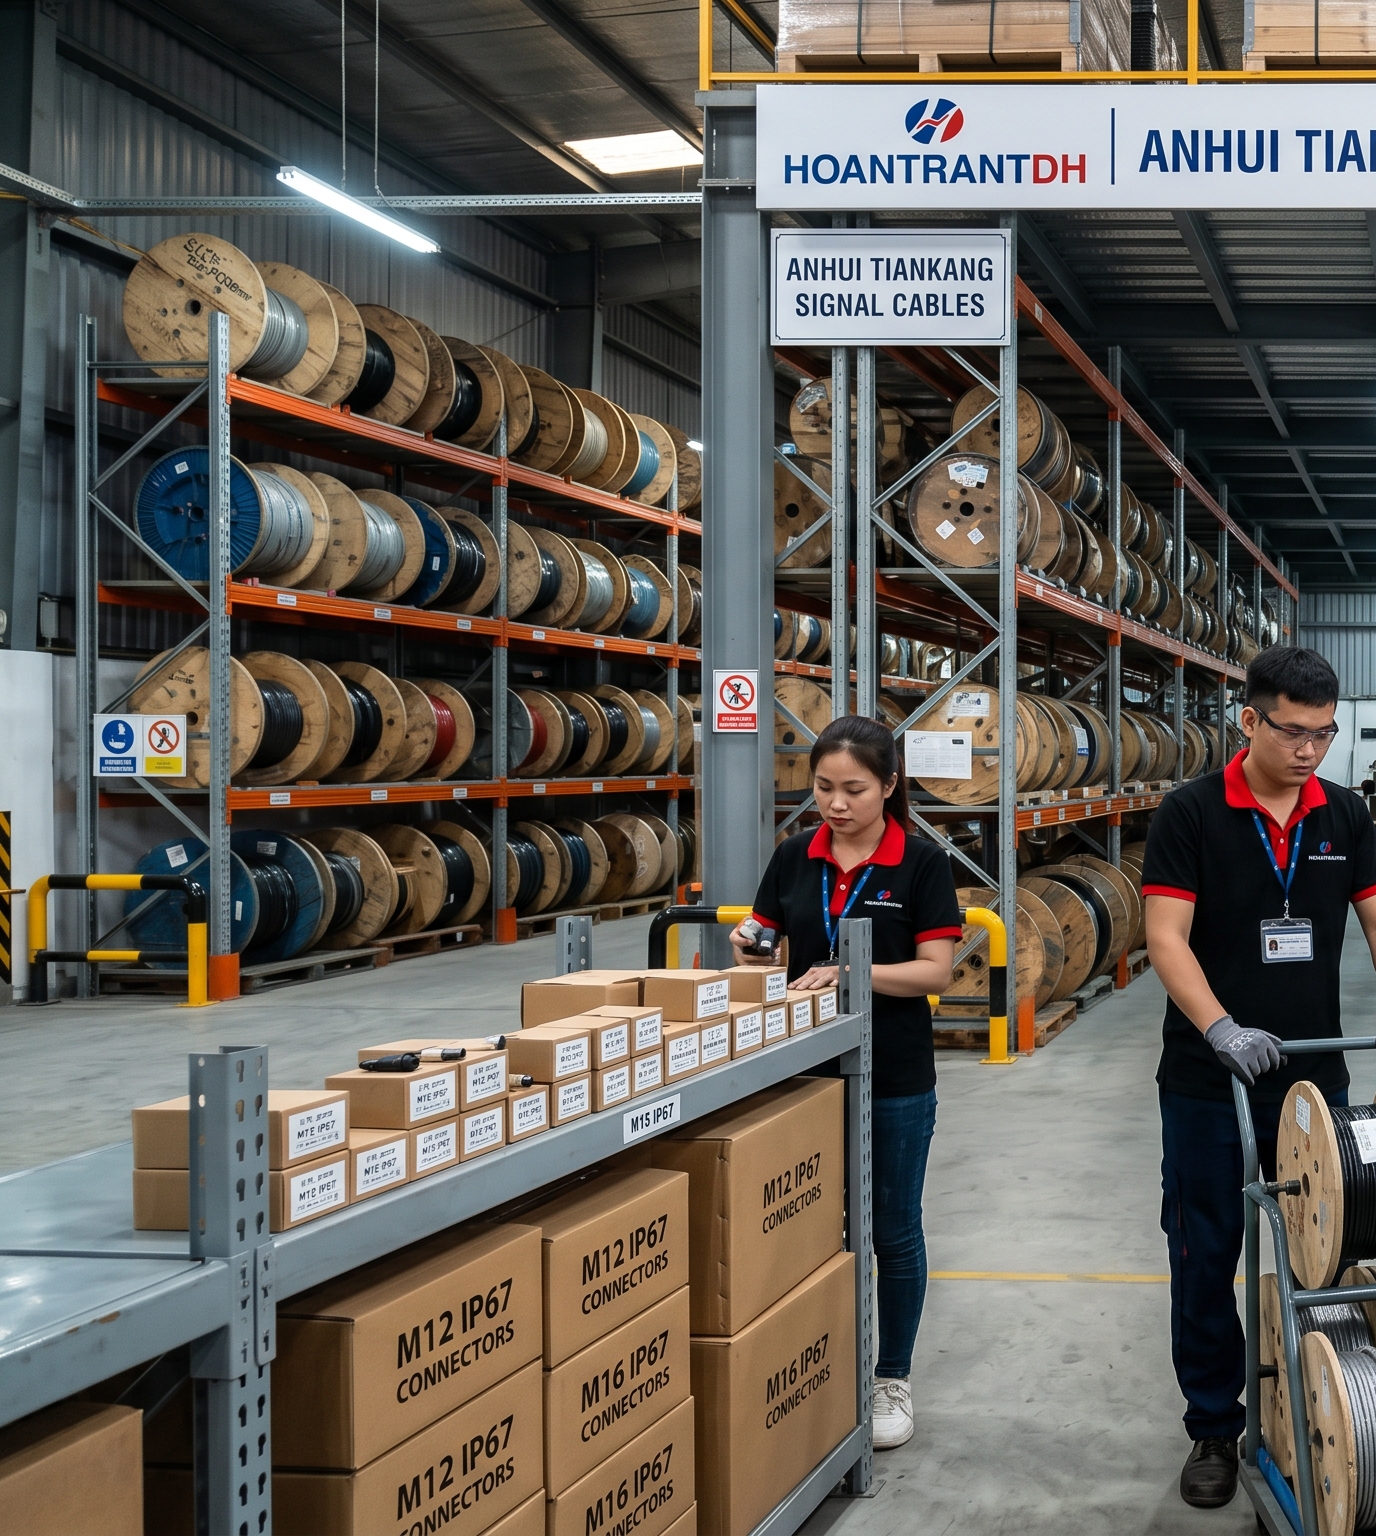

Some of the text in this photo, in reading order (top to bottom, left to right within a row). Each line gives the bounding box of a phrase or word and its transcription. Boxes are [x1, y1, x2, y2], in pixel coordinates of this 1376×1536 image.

[784, 154, 1086, 185] HOANTRANTDH
[1139, 130, 1279, 173] ANHUI
[787, 257, 993, 282] ANHUI TIANKANG
[795, 293, 985, 317] SIGNAL CABLES
[631, 1102, 675, 1134] M15 IP67
[762, 1183, 822, 1234] CONNECTORS
[763, 1152, 821, 1209] M12 IP67
[581, 1249, 669, 1315] CONNECTORS
[582, 1213, 668, 1286] M12 IP67
[397, 1277, 514, 1370] M12 IP67
[396, 1319, 515, 1404] CONNECTORS
[581, 1329, 669, 1414] M16 IP67
[766, 1332, 829, 1405] M16 IP67
[581, 1365, 670, 1443] CONNECTORS
[765, 1363, 831, 1430] CONNECTORS
[396, 1413, 514, 1522] M12 IP67
[585, 1442, 674, 1536] M16 IP67
